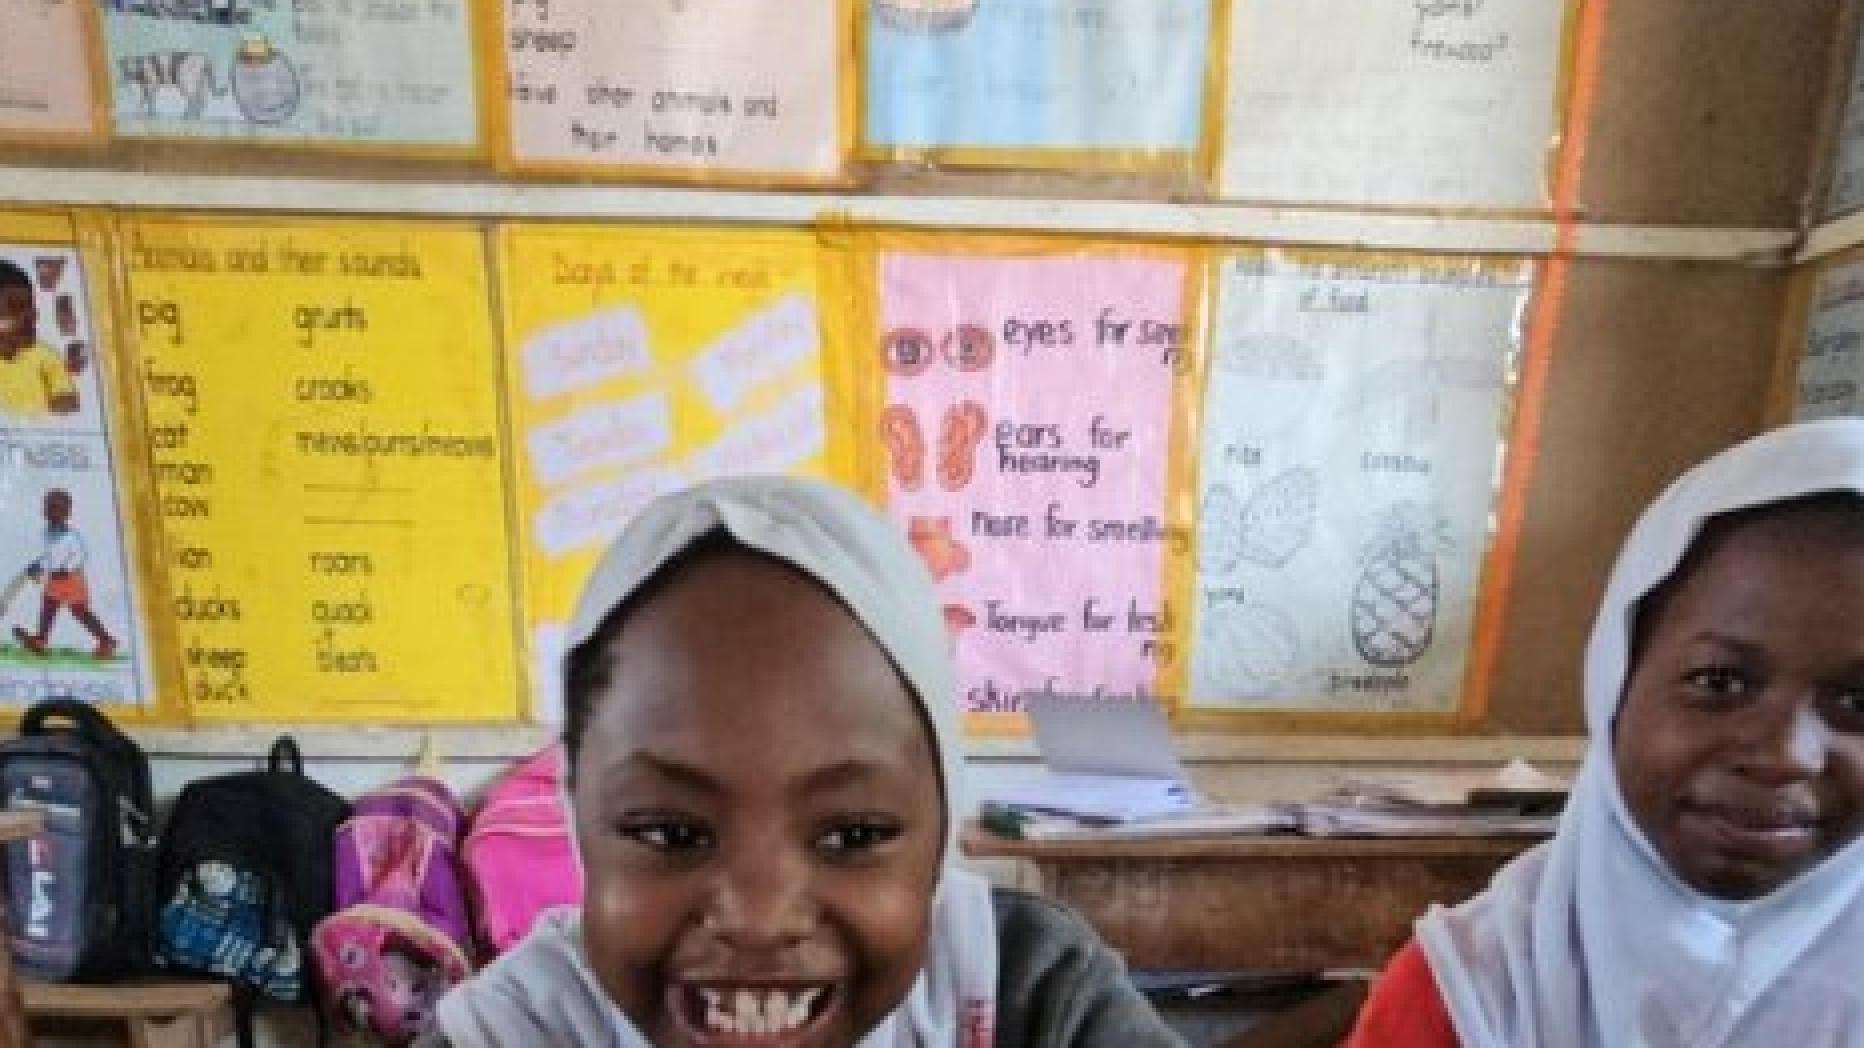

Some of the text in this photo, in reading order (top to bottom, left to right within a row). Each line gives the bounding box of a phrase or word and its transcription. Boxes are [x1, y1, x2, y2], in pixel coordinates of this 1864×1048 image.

[511, 30, 577, 58] sheep
[743, 90, 779, 121] and
[225, 237, 270, 273] and
[338, 238, 422, 280] sounds
[138, 292, 184, 345] pig
[1002, 317, 1077, 357] eyes
[1096, 306, 1134, 348] for
[995, 414, 1133, 449] ears for
[999, 443, 1101, 488] hearing
[1044, 502, 1077, 540] for
[984, 598, 1066, 641] Tongue
[1082, 595, 1116, 633] for
